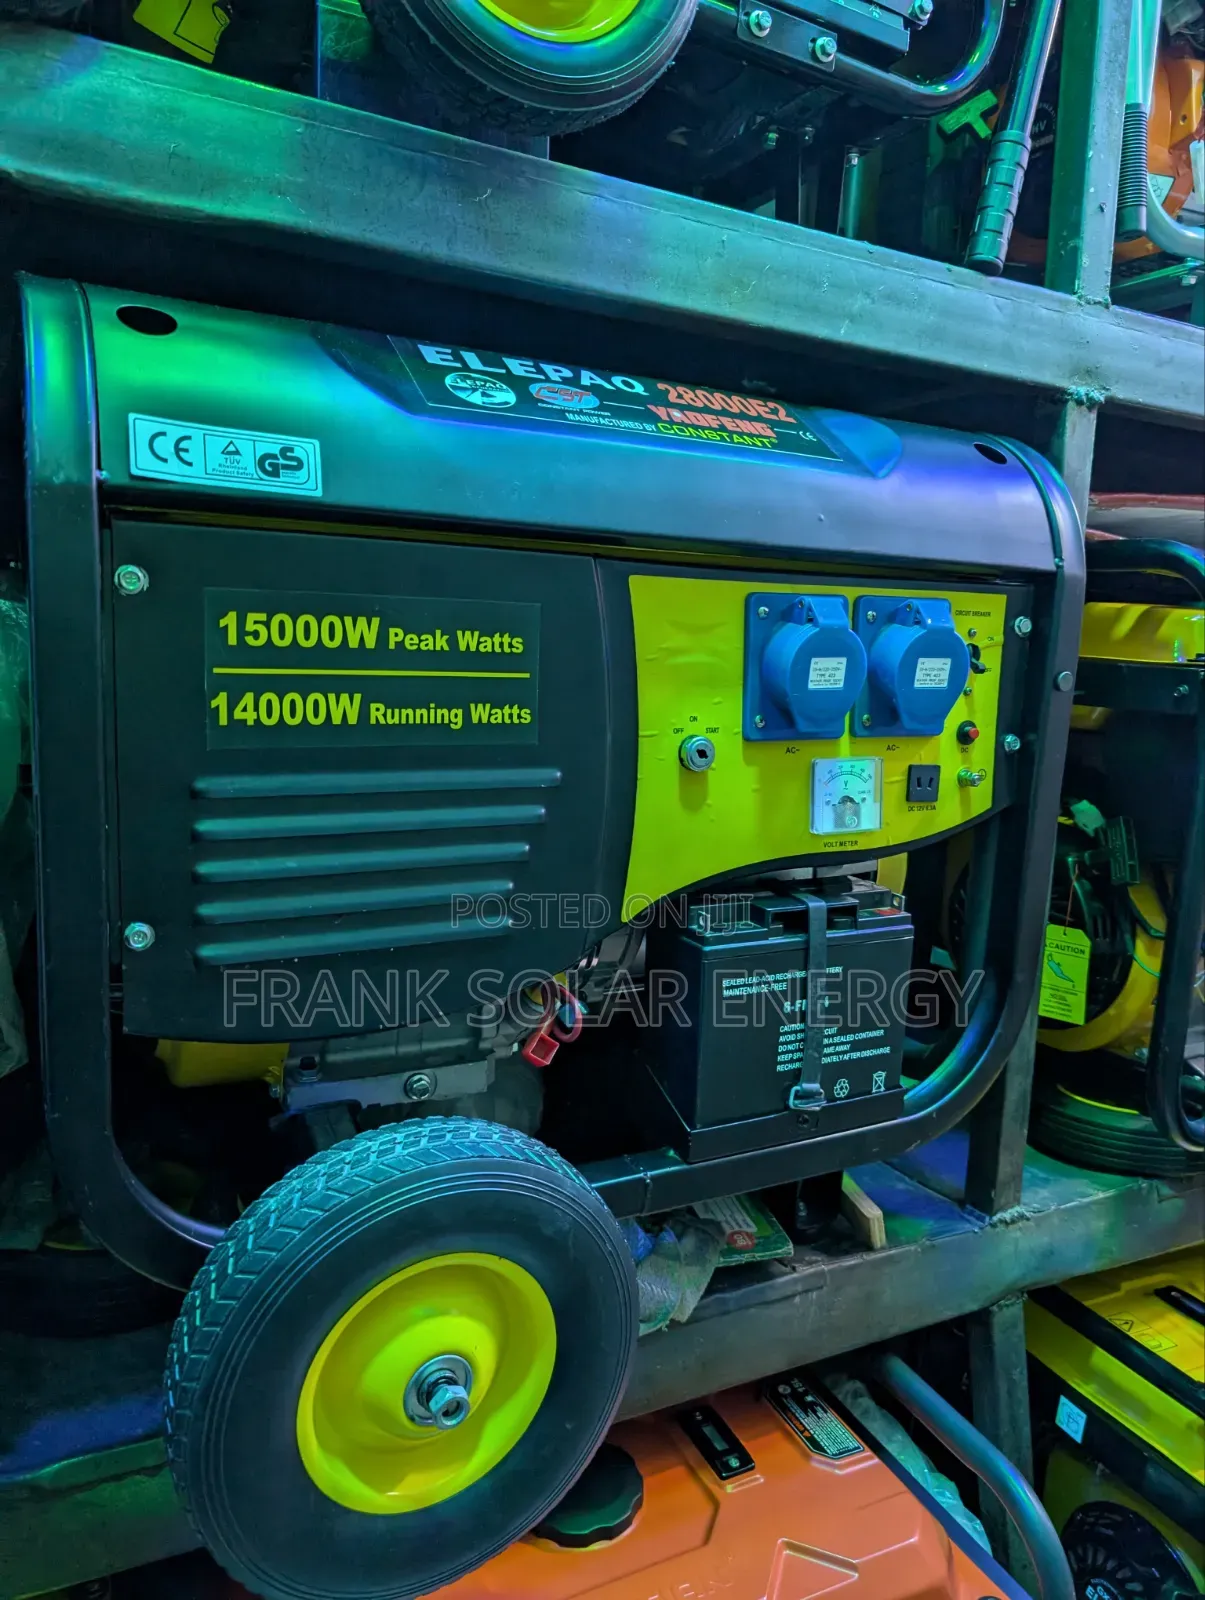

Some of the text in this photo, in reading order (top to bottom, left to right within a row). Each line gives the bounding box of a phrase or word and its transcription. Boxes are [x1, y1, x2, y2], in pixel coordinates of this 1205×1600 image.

[417, 343, 650, 396] ELEPAQ
[656, 383, 798, 423] 28000E2
[566, 412, 657, 432] MANUFACTURED BY
[148, 431, 193, 467] CE
[224, 456, 241, 465] TÜV
[257, 446, 304, 479] GS
[218, 610, 524, 653] 15000W Peak Watts
[210, 691, 531, 729] 14000W Running Watts
[689, 715, 698, 723] ON
[673, 727, 684, 735] OFF
[1049, 943, 1086, 956] CAUTION
[722, 966, 843, 987] SEALED LEAD-ACID RECHARGE TTERY
[723, 982, 788, 997] MAINTENANCE-FREE
[778, 1027, 838, 1042] AVOID SH CUIT
[787, 1043, 799, 1051] NOT
[833, 1034, 854, 1043] SEALED
[854, 1029, 884, 1040] CONTAINER
[777, 1044, 851, 1062] KEEP SPA AME AWAY
[821, 1054, 843, 1064] DIATELY
[843, 1051, 860, 1060] AFTER
[860, 1046, 891, 1058] DISCHARGE
